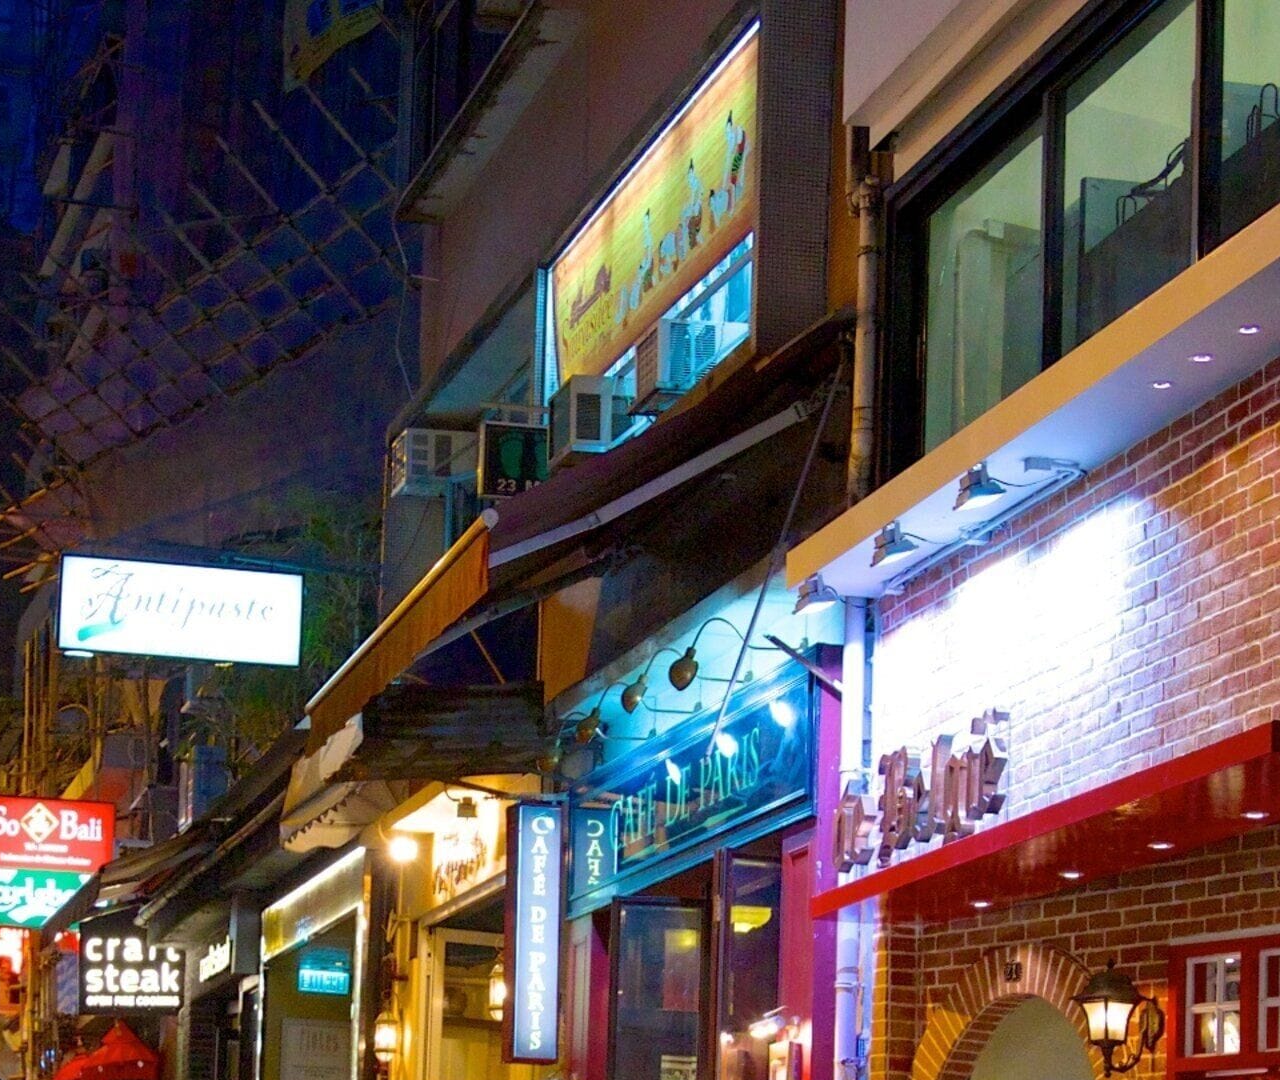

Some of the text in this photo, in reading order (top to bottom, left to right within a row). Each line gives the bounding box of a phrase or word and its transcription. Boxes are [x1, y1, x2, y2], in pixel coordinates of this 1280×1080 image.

[663, 762, 692, 828] DE
[697, 726, 761, 812] PARIS
[59, 809, 103, 842] Bali
[527, 816, 552, 1050] CAFÉ DE PARIS
[85, 961, 180, 993] steak
